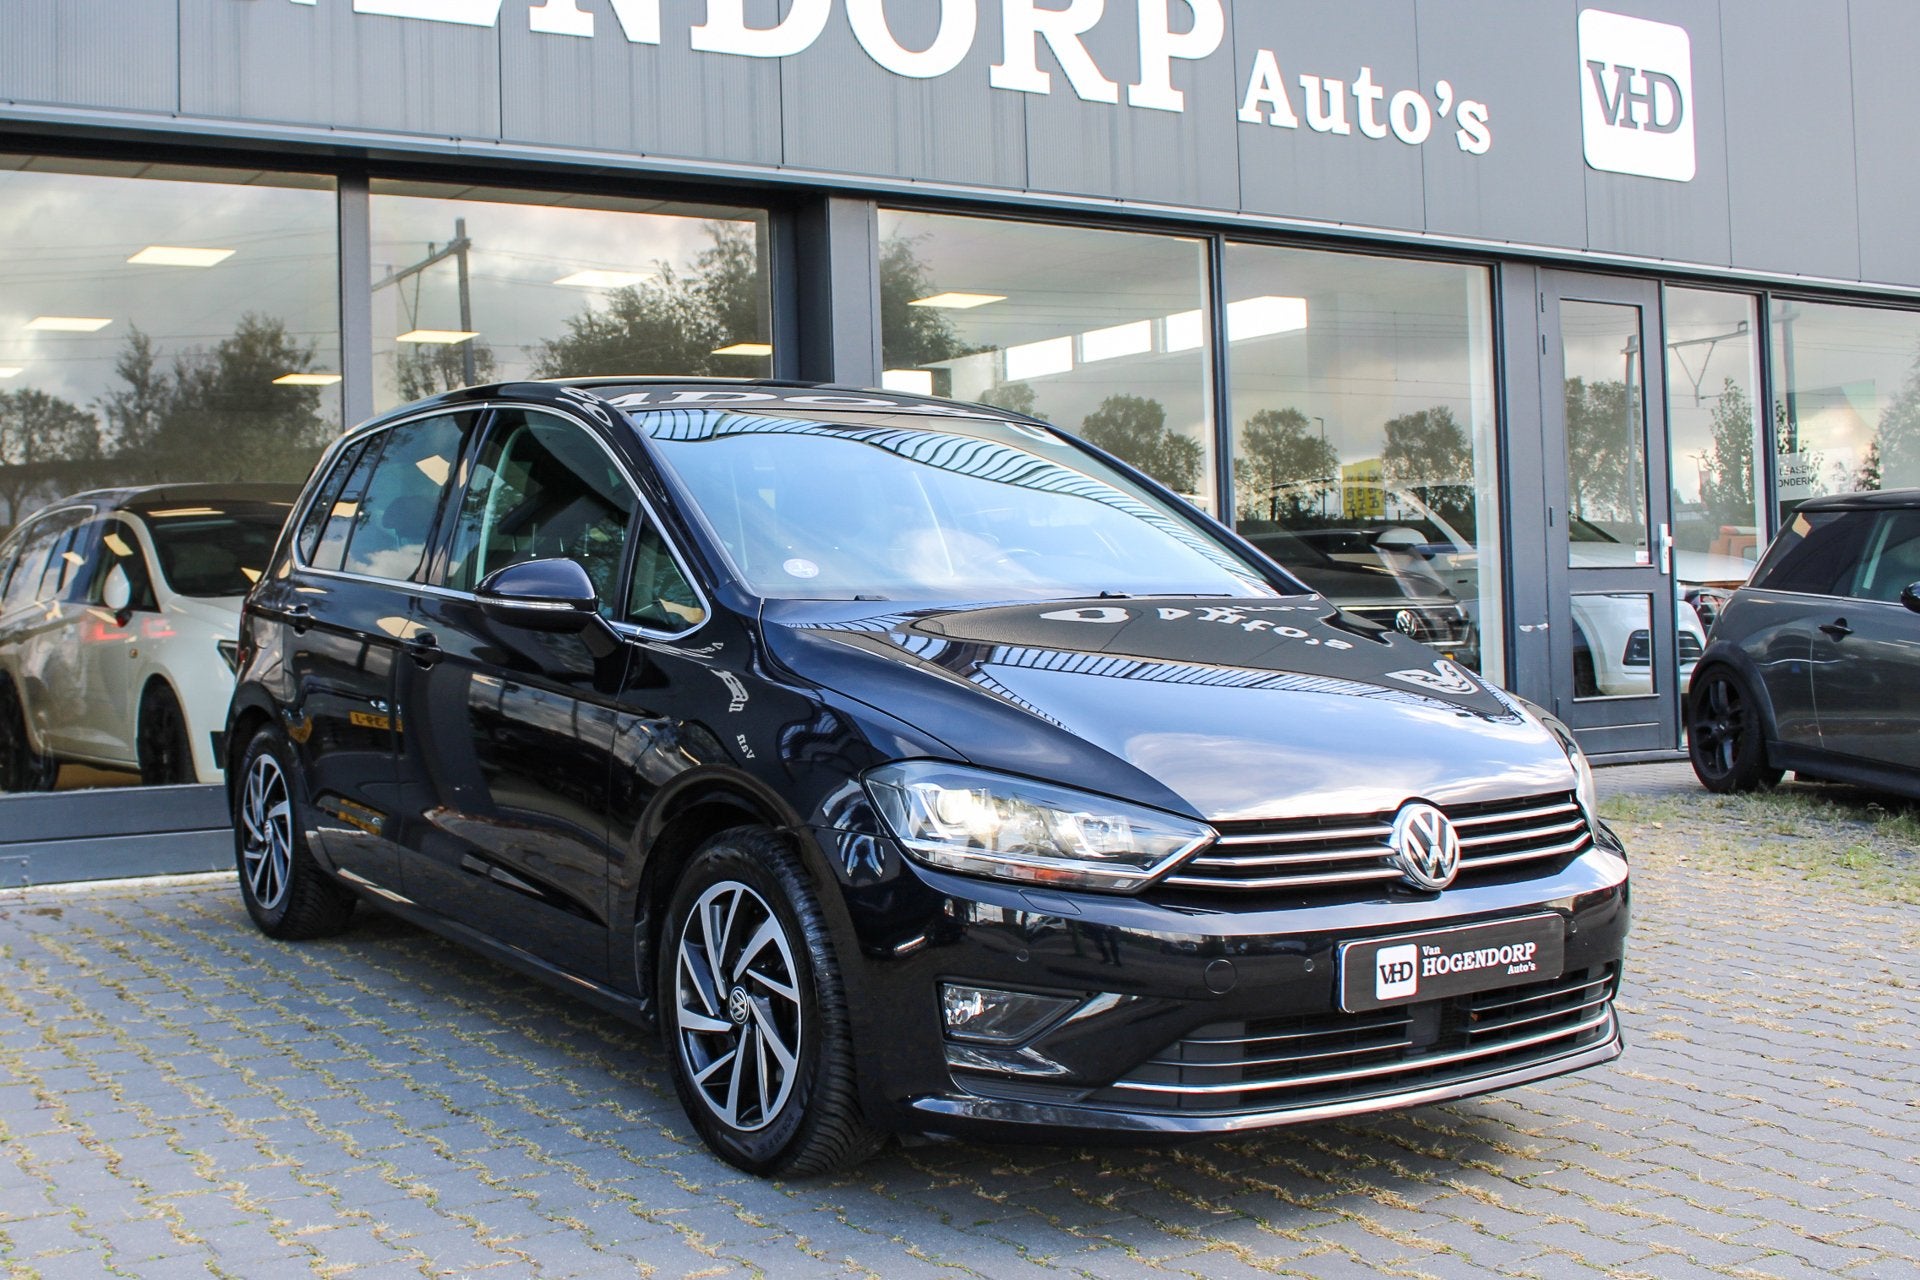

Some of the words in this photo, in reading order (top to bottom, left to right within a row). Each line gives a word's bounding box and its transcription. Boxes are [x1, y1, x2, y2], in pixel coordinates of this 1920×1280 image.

[1238, 48, 1491, 155] Auto's
[1586, 59, 1683, 134] VHD
[1421, 942, 1537, 978] HOGENDORP
[1422, 945, 1441, 956] Van
[1379, 961, 1414, 985] VHD
[1507, 962, 1537, 976] Auto's
